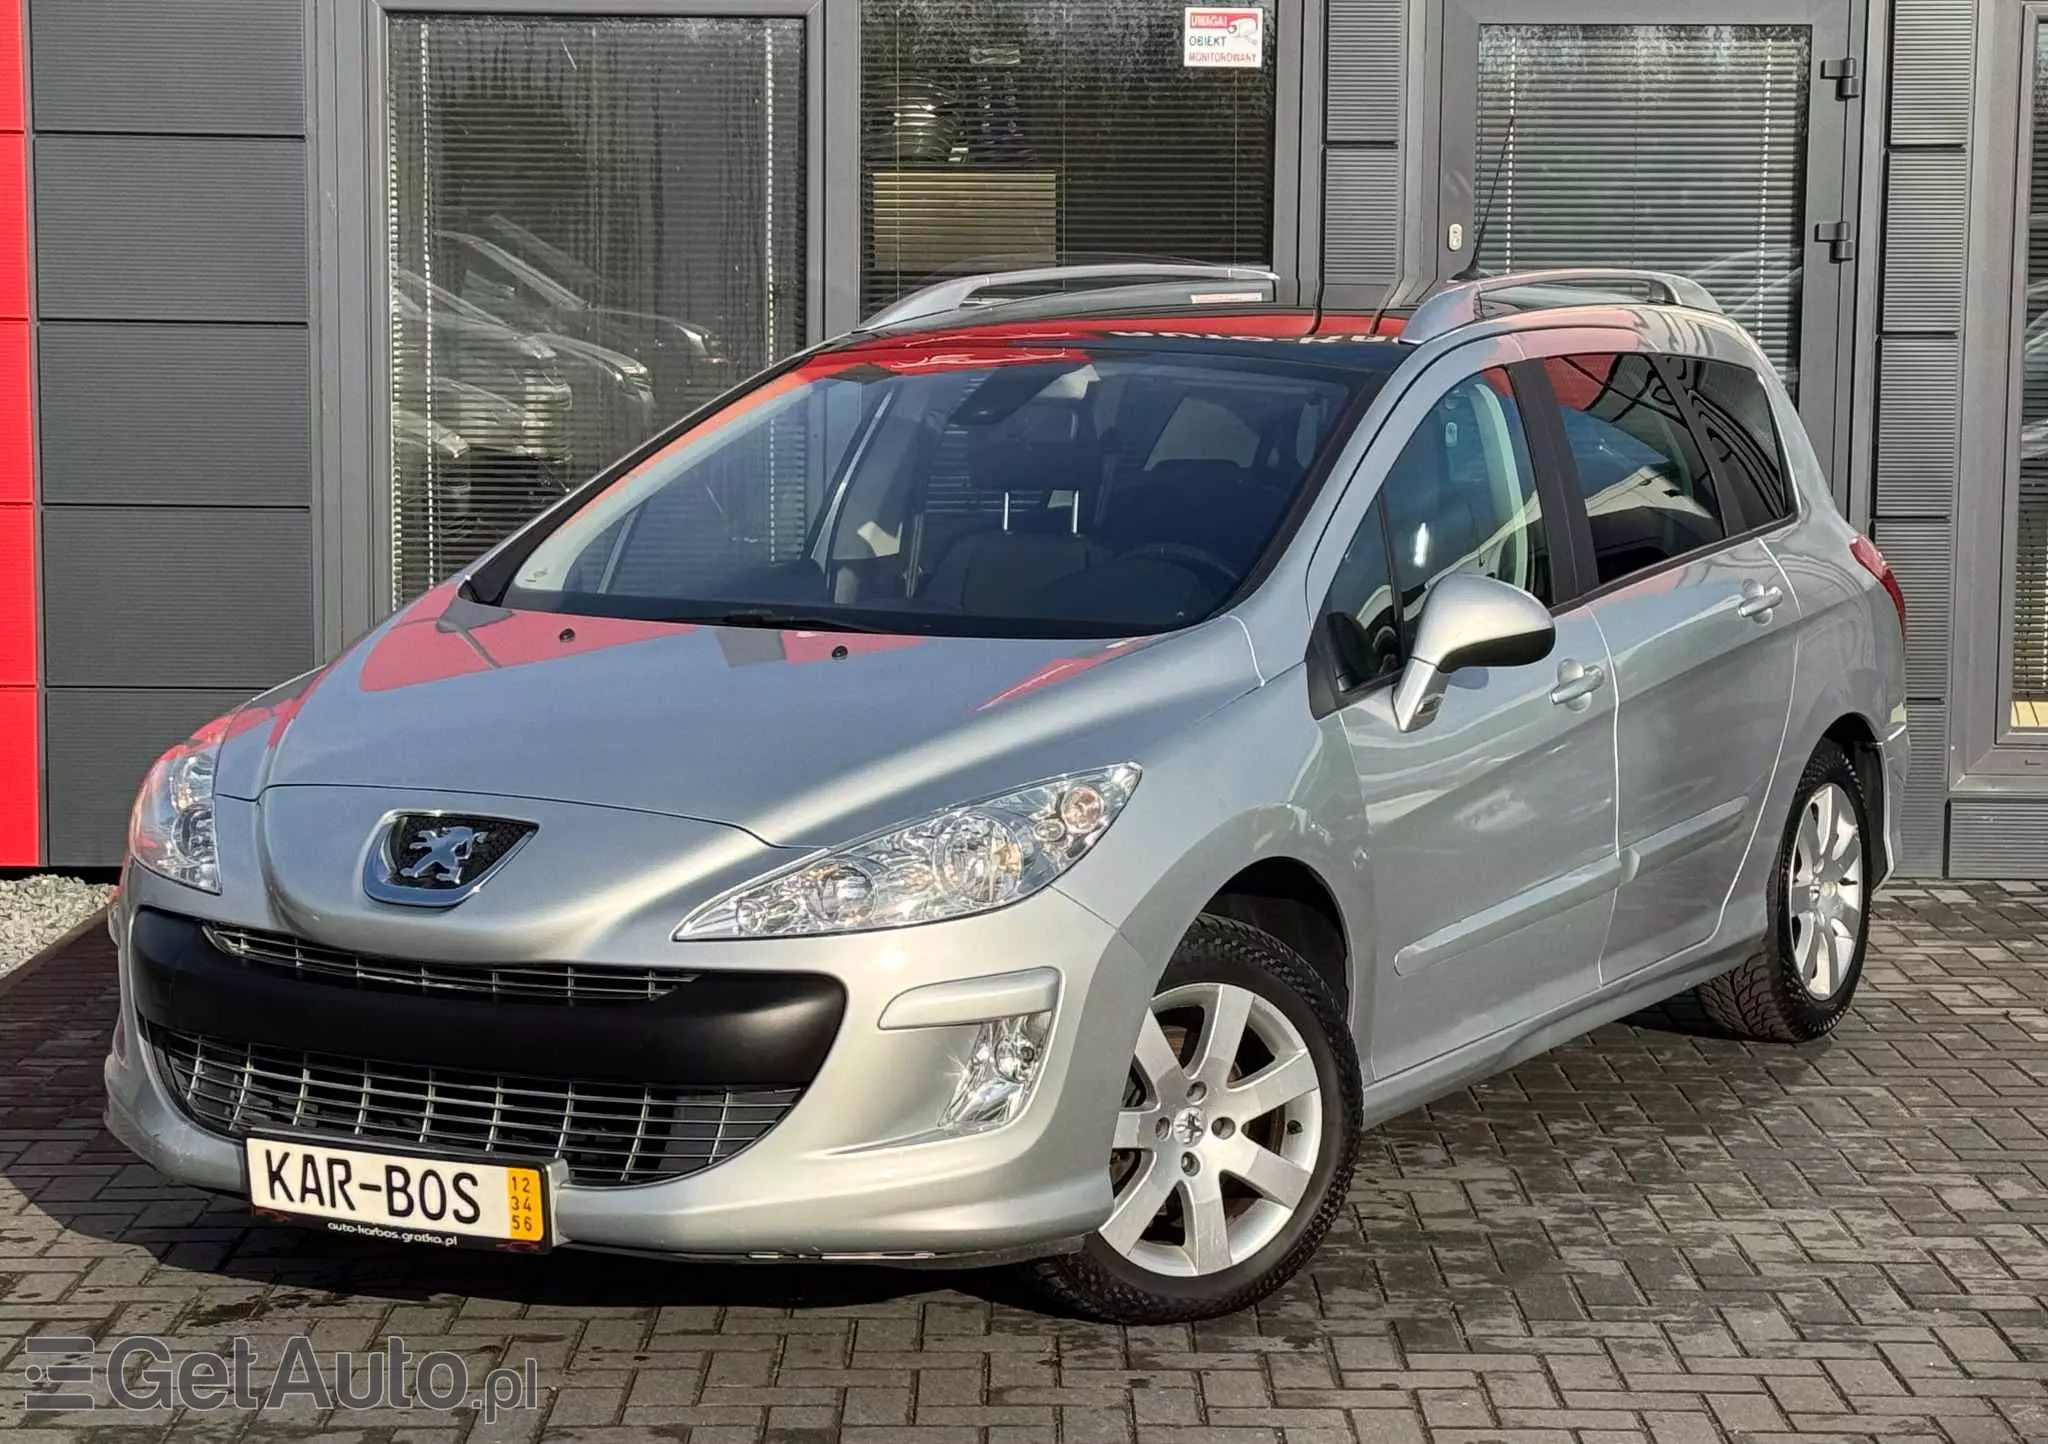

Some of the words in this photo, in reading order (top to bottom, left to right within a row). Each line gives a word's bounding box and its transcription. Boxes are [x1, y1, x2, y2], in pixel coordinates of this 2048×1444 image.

[1189, 36, 1226, 46] OBIEKT
[265, 1149, 481, 1224] KAR-BOS
[512, 1176, 530, 1193] 12
[511, 1196, 532, 1212] 34
[512, 1215, 532, 1232] 56
